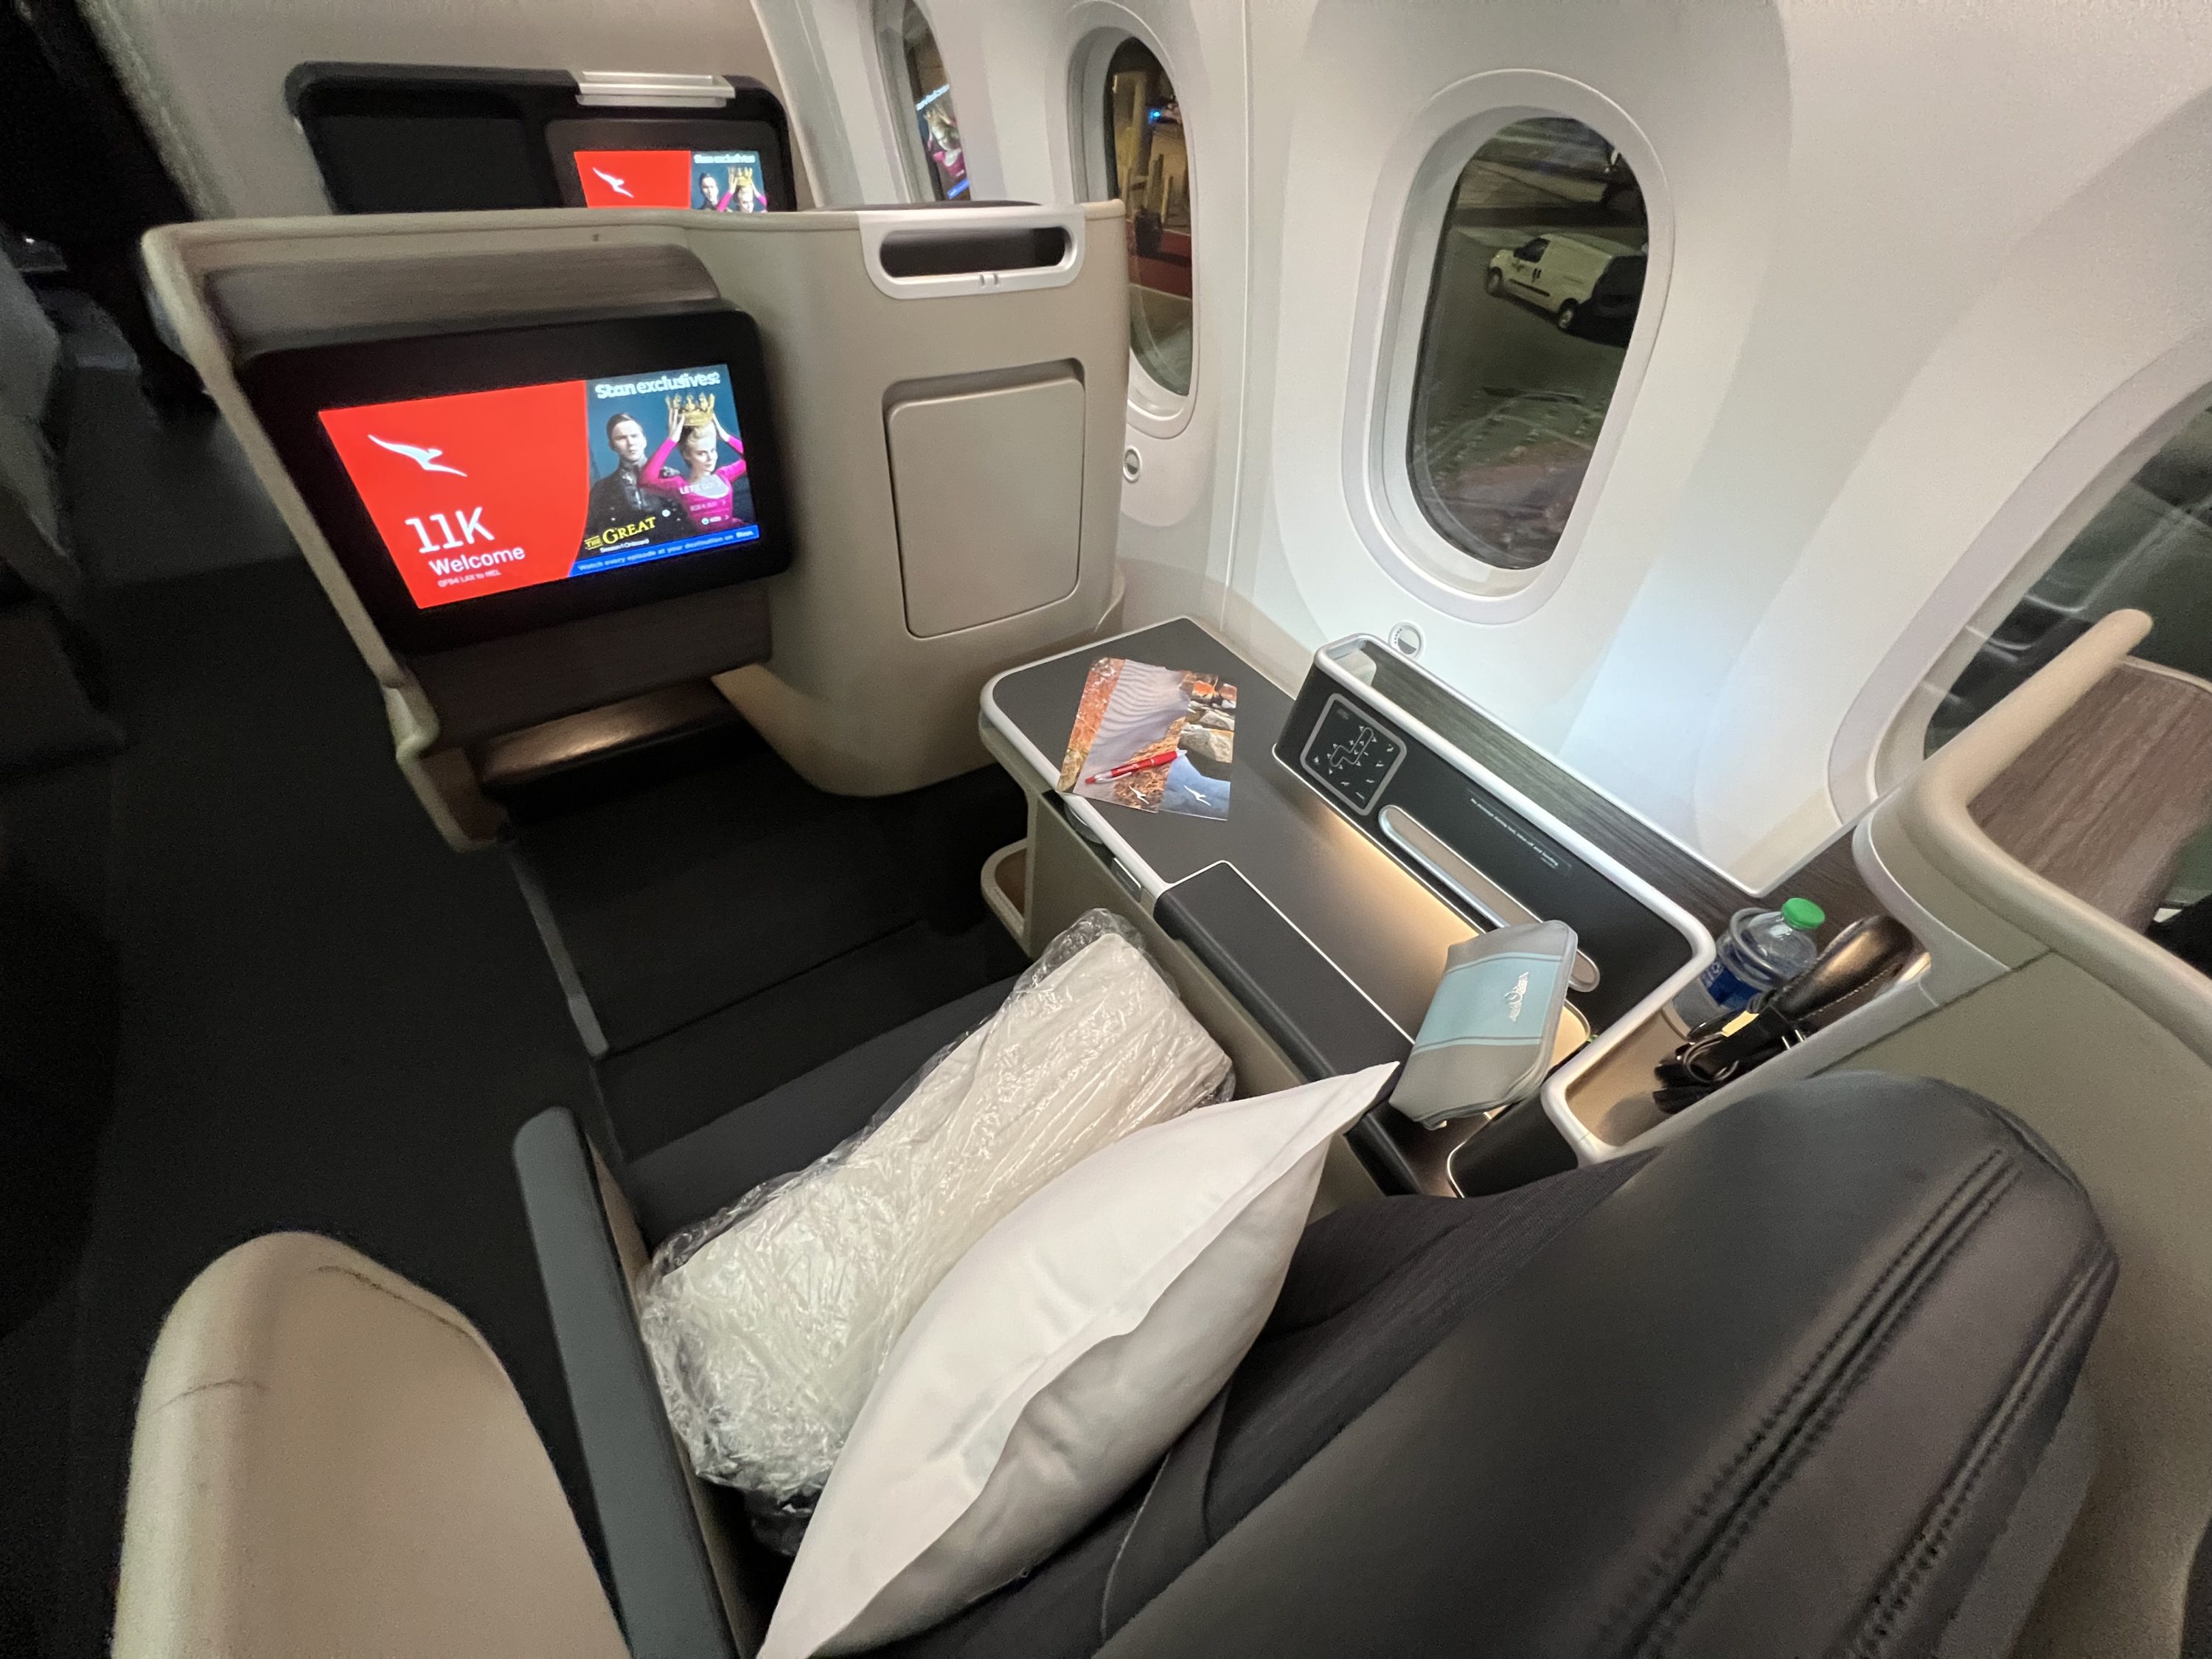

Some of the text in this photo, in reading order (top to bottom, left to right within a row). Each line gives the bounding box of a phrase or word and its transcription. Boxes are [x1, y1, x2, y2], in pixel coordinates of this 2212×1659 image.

[595, 383, 637, 399] Stan
[405, 506, 495, 553] 11K
[428, 546, 526, 576] Welcome
